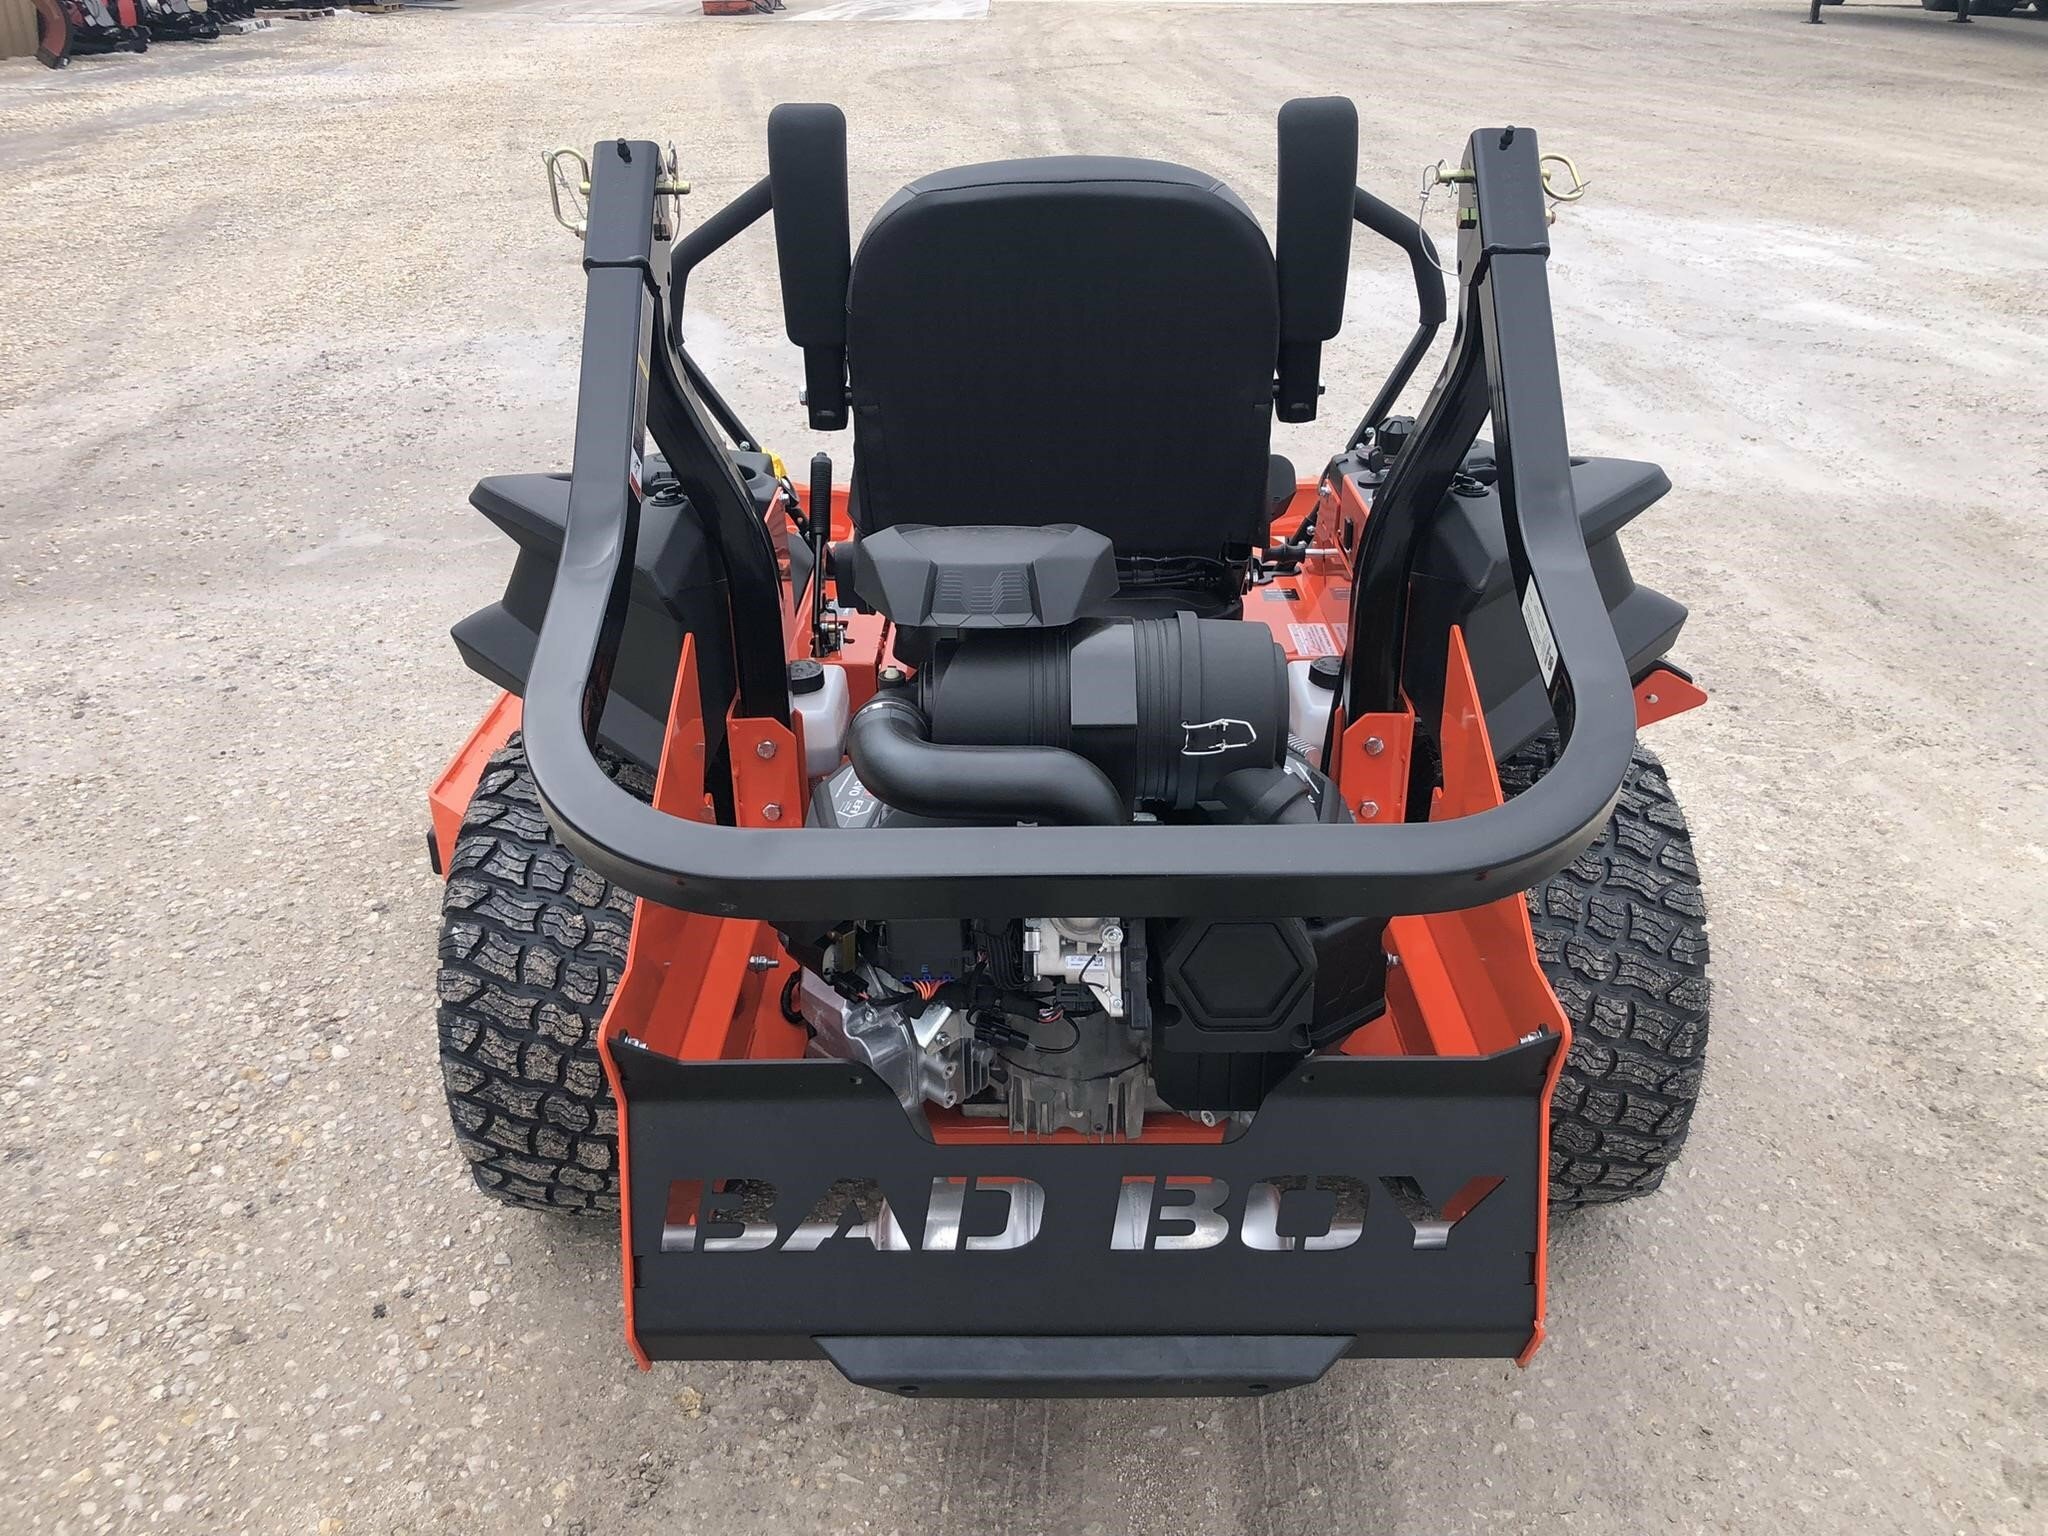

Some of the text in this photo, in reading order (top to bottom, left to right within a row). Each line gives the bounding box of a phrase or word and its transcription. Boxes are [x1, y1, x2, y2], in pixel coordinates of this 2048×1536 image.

[849, 799, 864, 813] EFI
[660, 1175, 1509, 1252] BAD BOY
